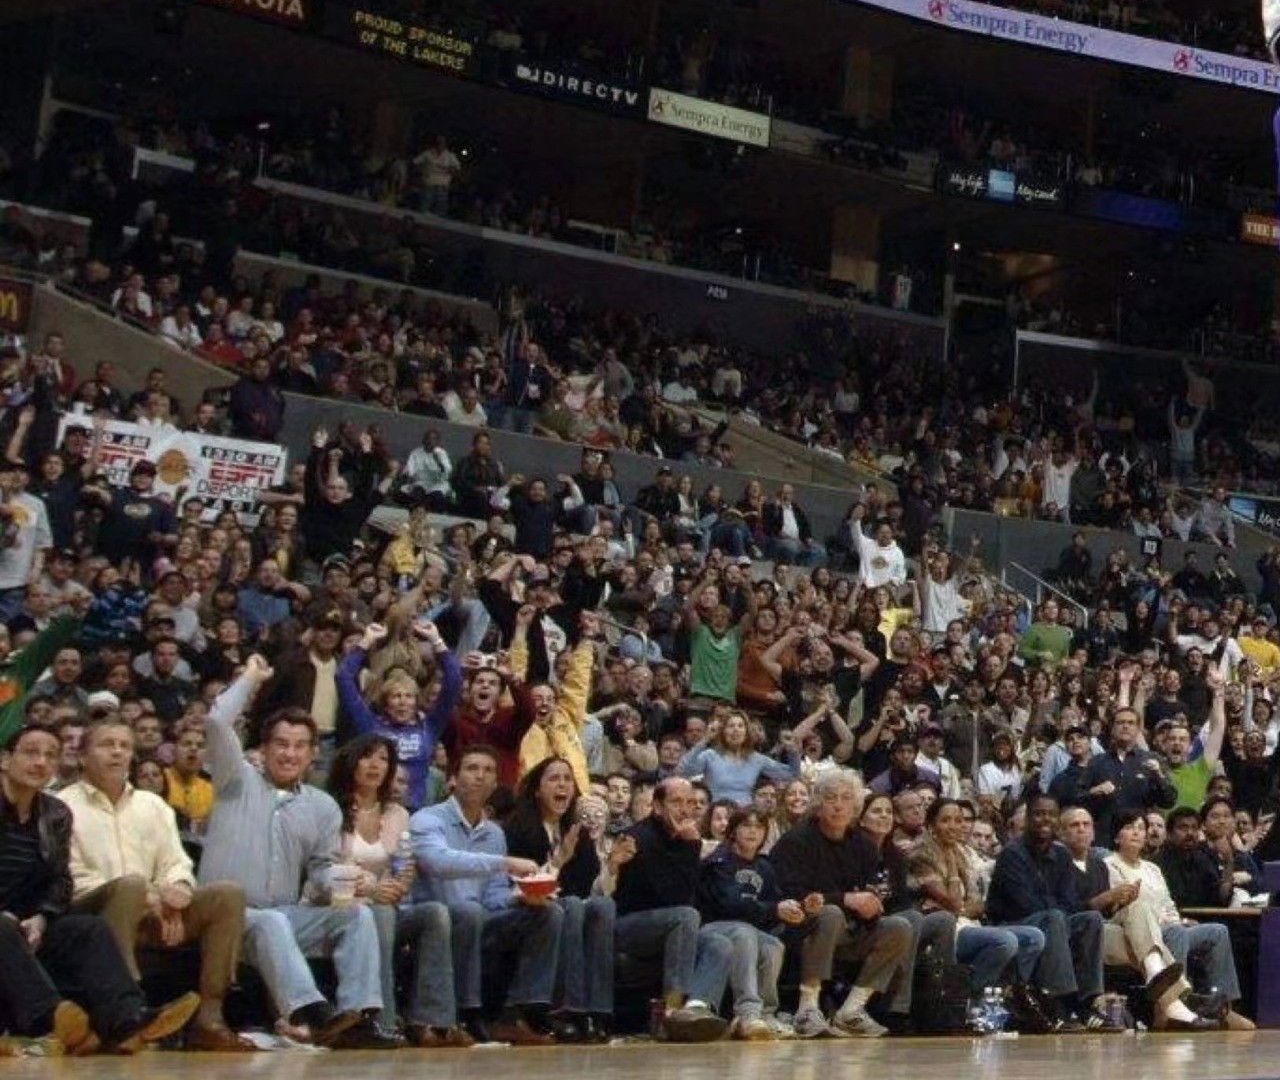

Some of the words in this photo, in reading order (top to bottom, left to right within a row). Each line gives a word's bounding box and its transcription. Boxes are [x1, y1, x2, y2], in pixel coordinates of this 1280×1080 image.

[946, 1, 1021, 39] Sempra
[1022, 20, 1092, 54] Energy
[1193, 53, 1260, 86] Sempra
[543, 71, 639, 106] DIRECTV
